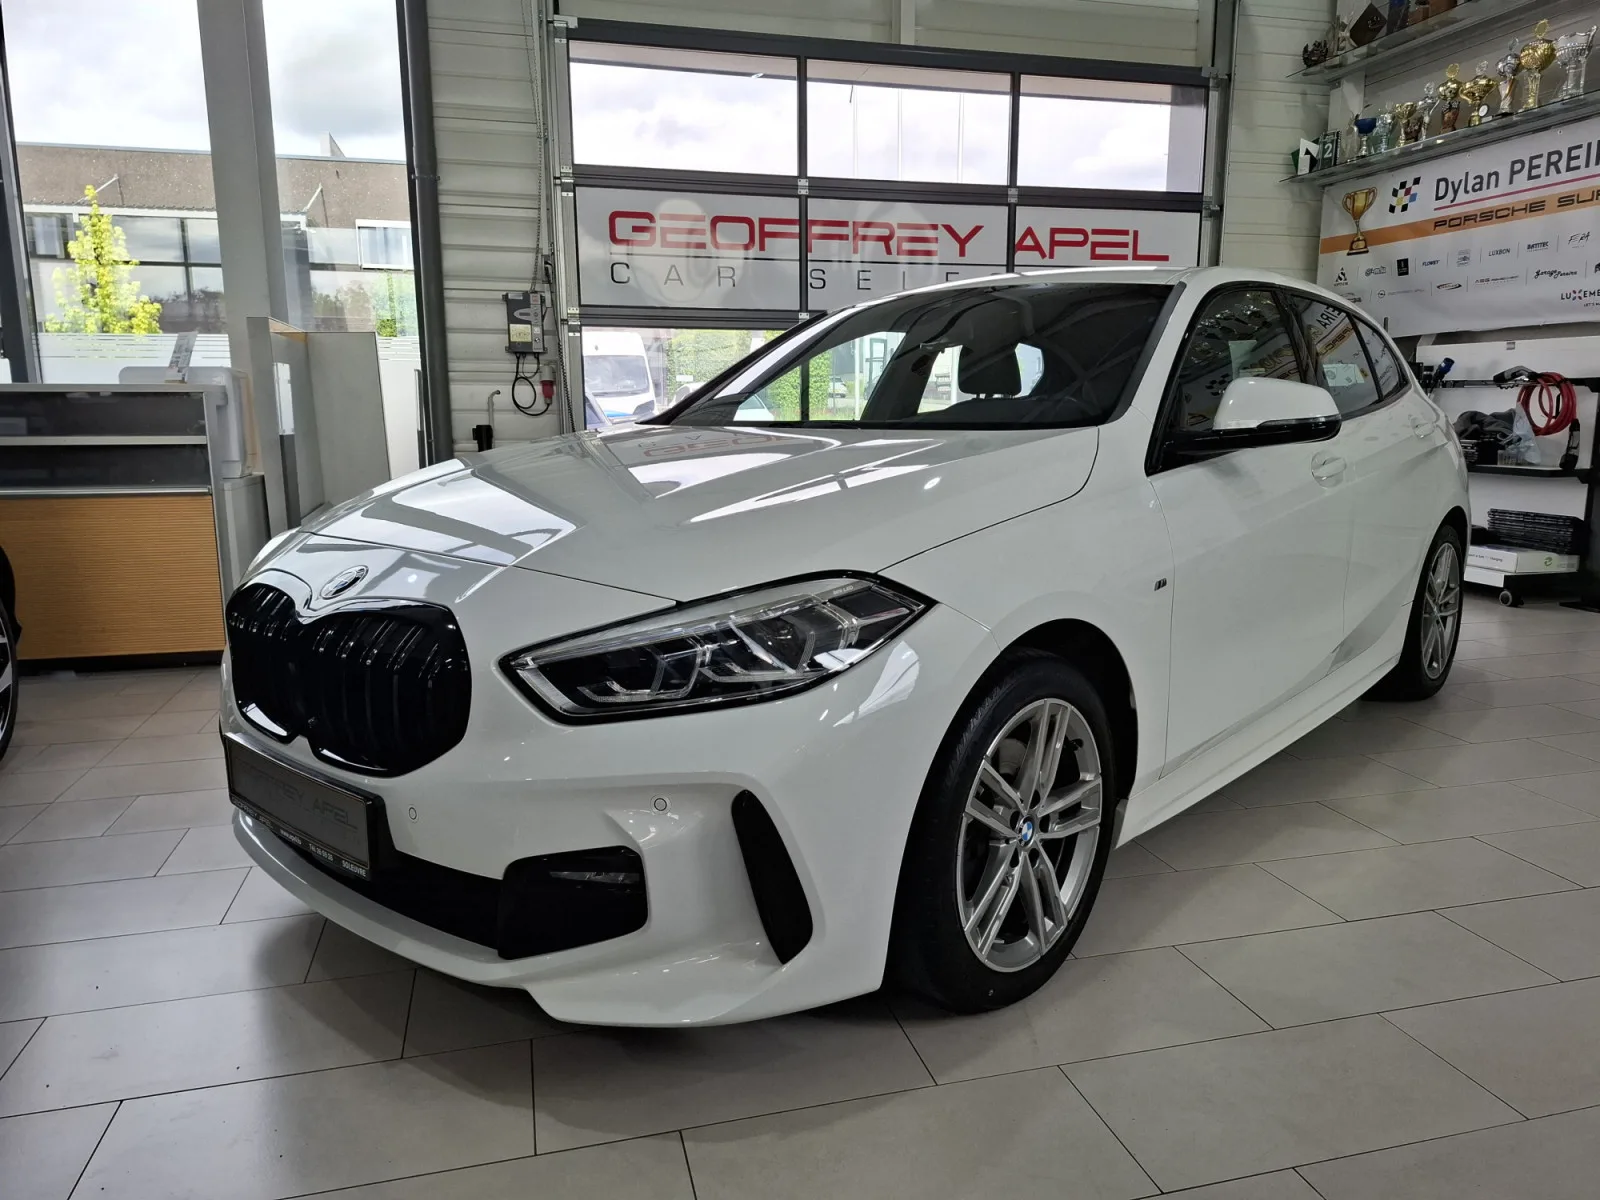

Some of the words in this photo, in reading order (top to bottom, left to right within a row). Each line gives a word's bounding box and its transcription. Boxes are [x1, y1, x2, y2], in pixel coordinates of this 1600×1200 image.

[1434, 170, 1500, 204] Dylan
[1433, 200, 1546, 231] PORSCHE
[608, 210, 985, 258] GEOFFREY
[1013, 226, 1170, 262] APEL
[610, 262, 737, 288] CAR
[809, 268, 1004, 291] SEL
